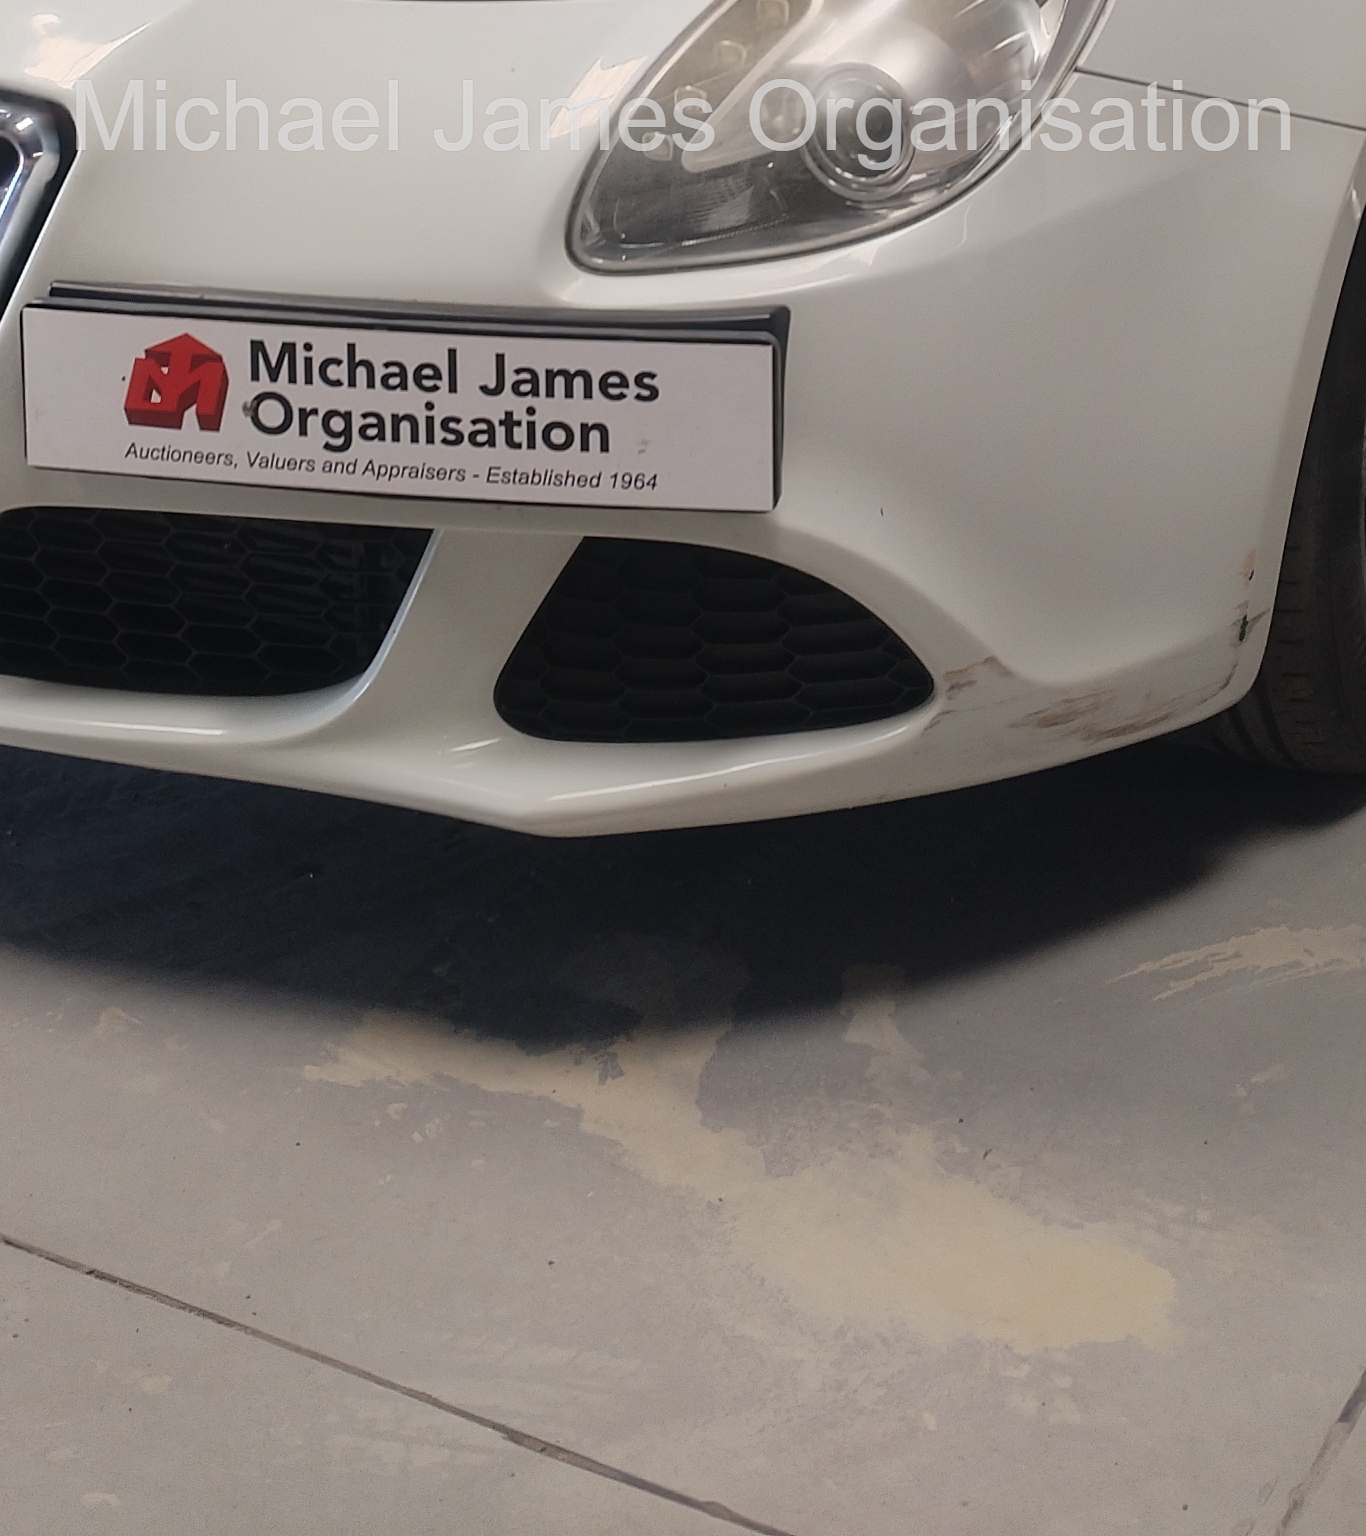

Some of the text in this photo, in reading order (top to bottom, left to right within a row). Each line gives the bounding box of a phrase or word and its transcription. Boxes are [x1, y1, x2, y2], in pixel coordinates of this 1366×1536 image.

[249, 339, 660, 402] Michael James
[248, 391, 611, 454] Organisation
[125, 441, 238, 468] Auctioneers,
[246, 451, 316, 474] Valuers
[321, 458, 357, 476] and
[362, 458, 466, 482] Appraisers
[486, 466, 602, 490] Established
[608, 472, 659, 492] 1964
